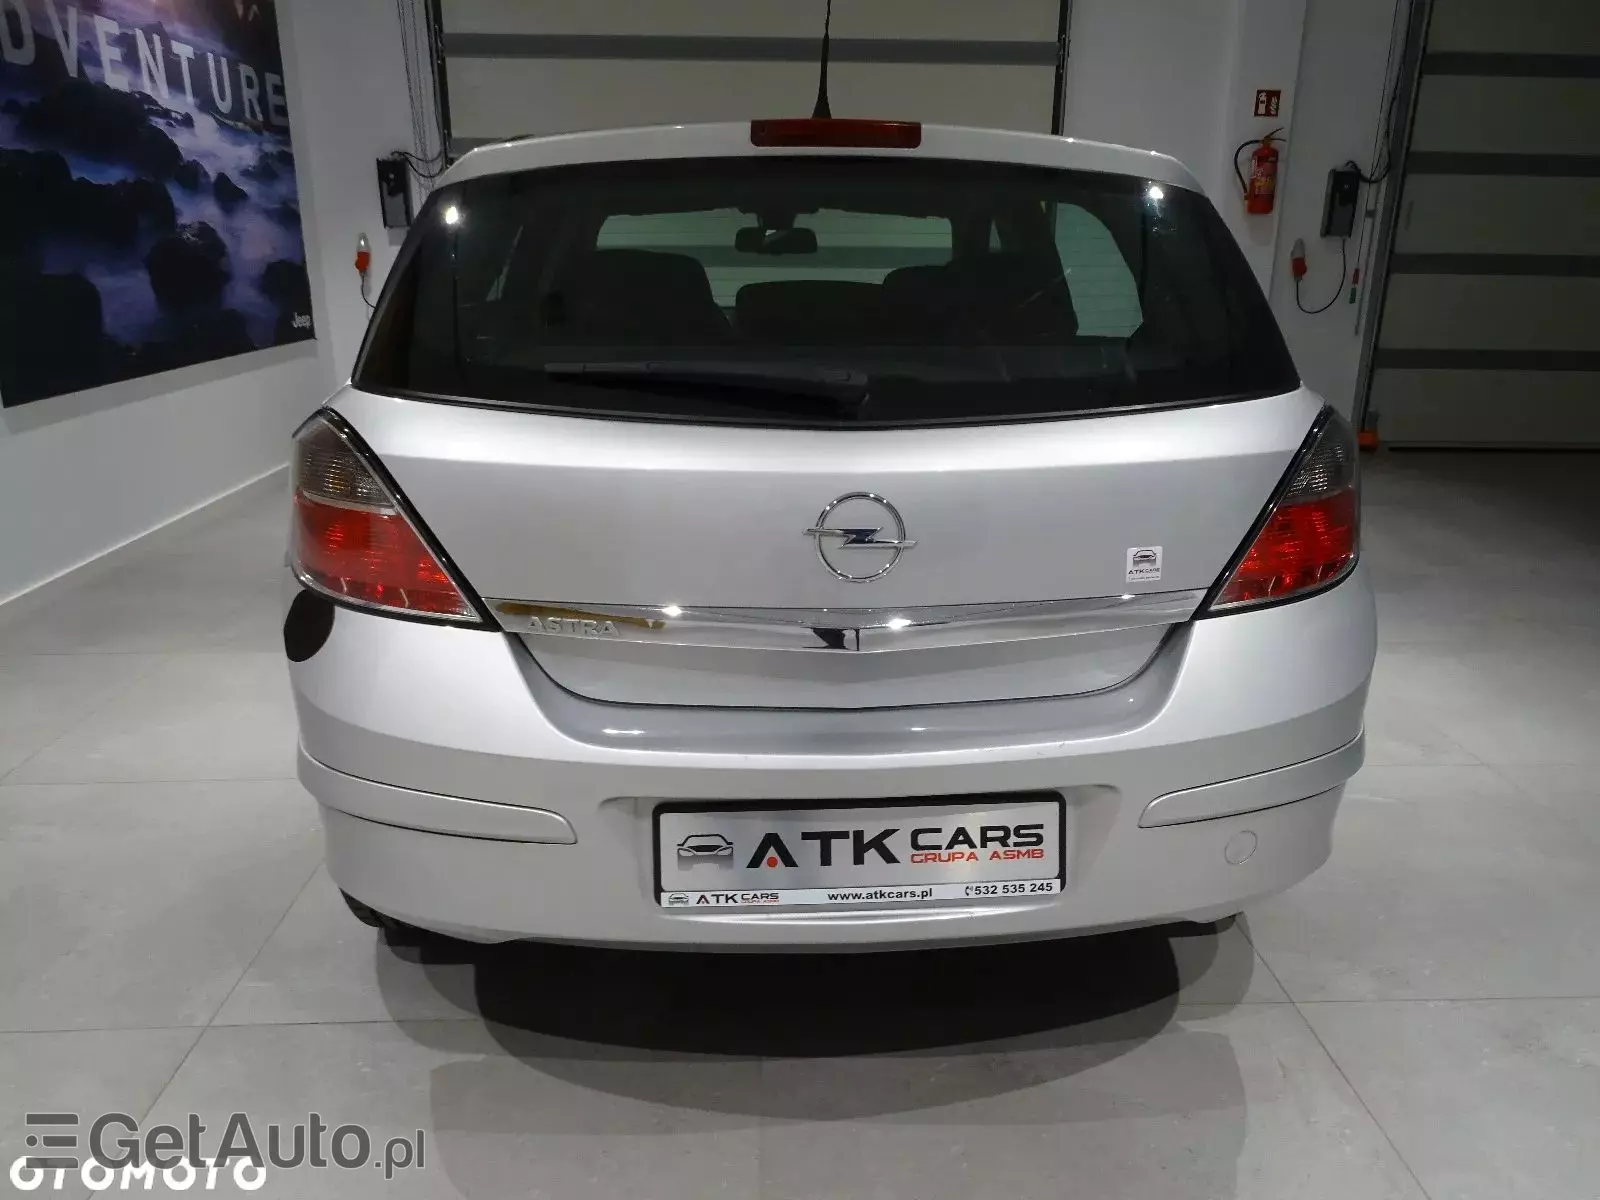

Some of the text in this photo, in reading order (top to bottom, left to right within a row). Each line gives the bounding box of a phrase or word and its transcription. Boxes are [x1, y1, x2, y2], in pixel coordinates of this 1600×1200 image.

[291, 311, 311, 329] Jeep
[527, 616, 620, 637] ASTRA
[746, 824, 1044, 868] ATK CARS
[910, 848, 1044, 864] GRUPA ASMB
[827, 888, 933, 901] www.atkcars.pl
[974, 882, 1054, 896] 532 535 245
[696, 893, 739, 905] ATK
[741, 892, 779, 900] CARS
